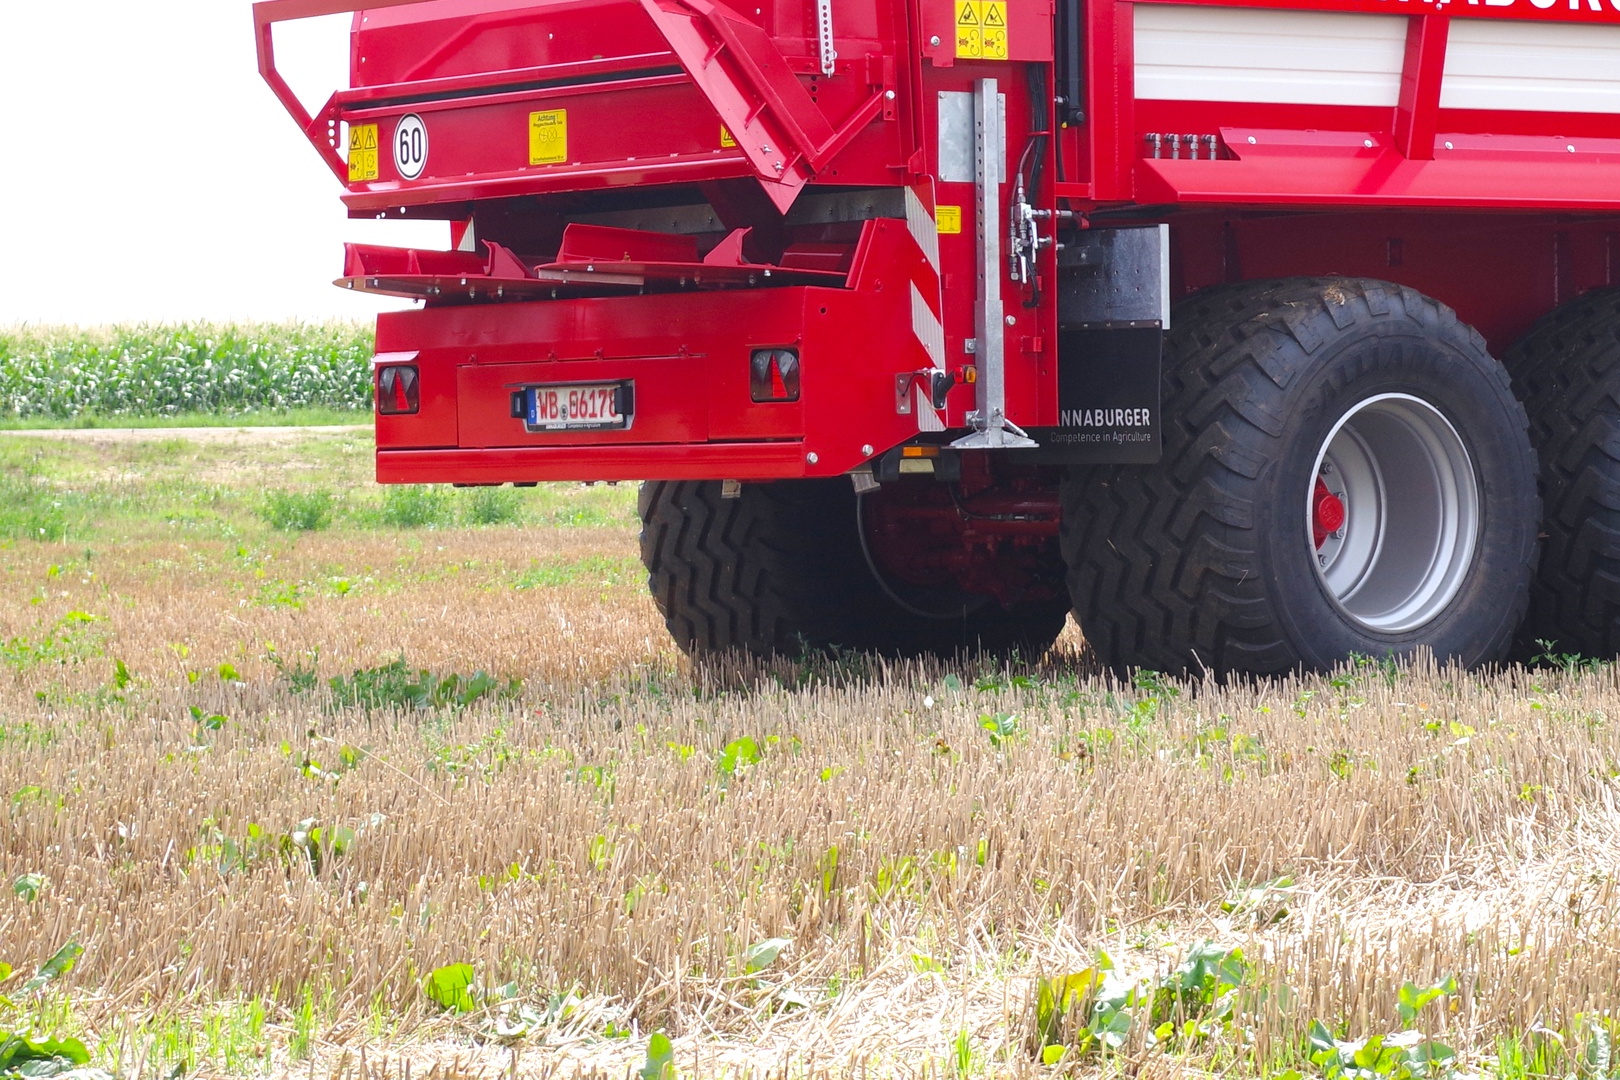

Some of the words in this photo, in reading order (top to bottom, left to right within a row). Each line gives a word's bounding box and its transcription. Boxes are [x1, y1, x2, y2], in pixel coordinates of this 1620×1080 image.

[400, 127, 422, 165] 60
[1319, 342, 1466, 408] ALLIANCE
[538, 390, 558, 419] WB
[1058, 408, 1151, 427] NNABURGER
[1050, 432, 1101, 444] Competence
[1103, 431, 1111, 441] in
[1112, 431, 1151, 444] Agriculture
